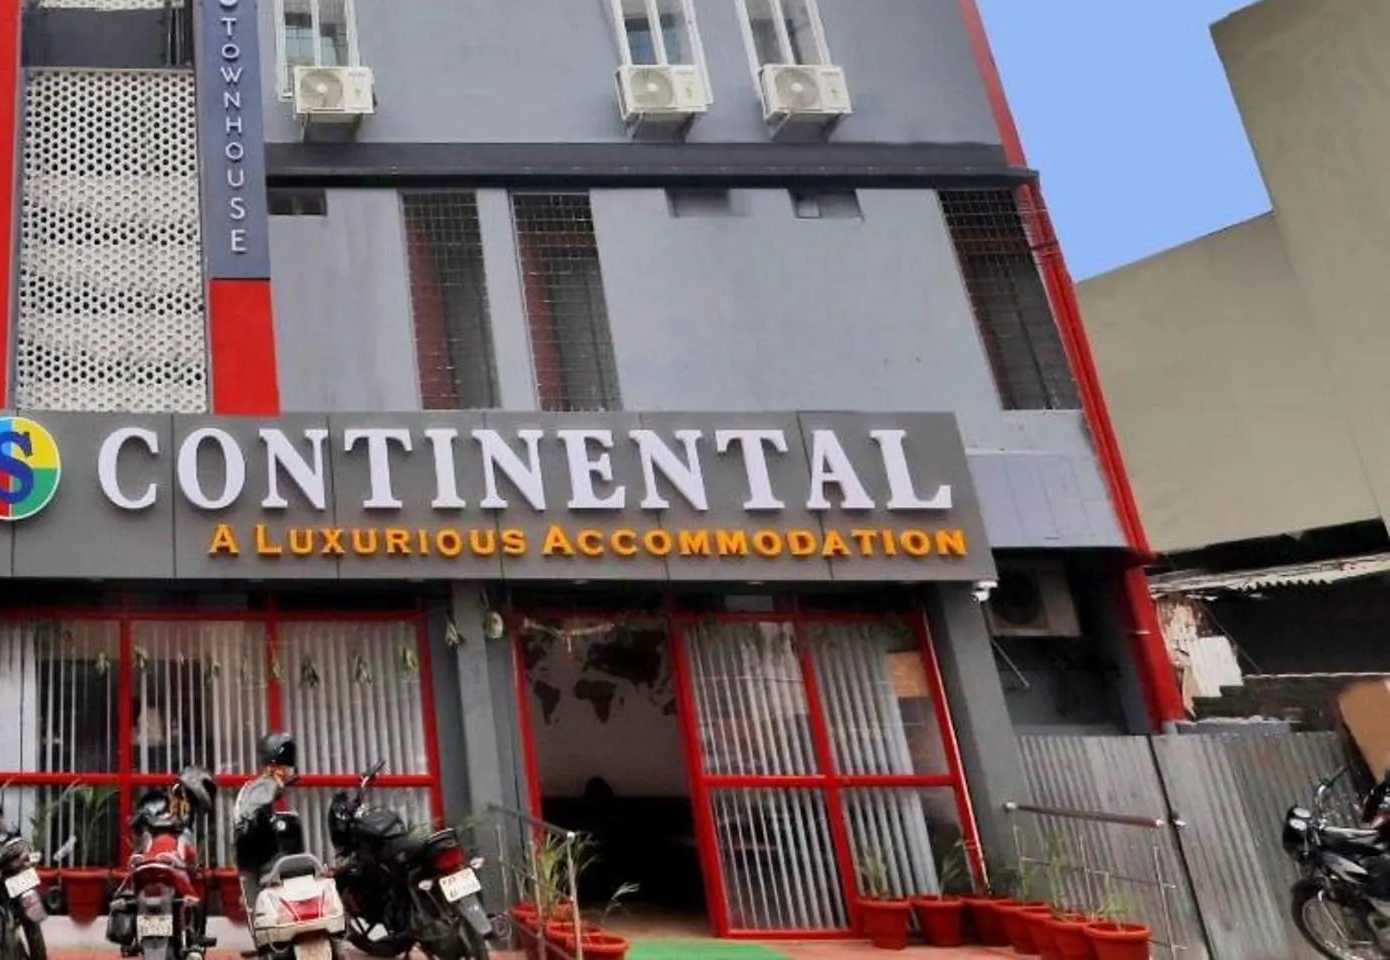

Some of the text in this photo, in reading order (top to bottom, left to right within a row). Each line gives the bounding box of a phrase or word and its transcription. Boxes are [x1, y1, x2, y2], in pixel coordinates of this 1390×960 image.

[220, 17, 247, 254] TOWNHOUSE
[96, 426, 953, 511] CONTINENTAL
[209, 523, 967, 559] A LUXURIOUS ACCOMMODATION
